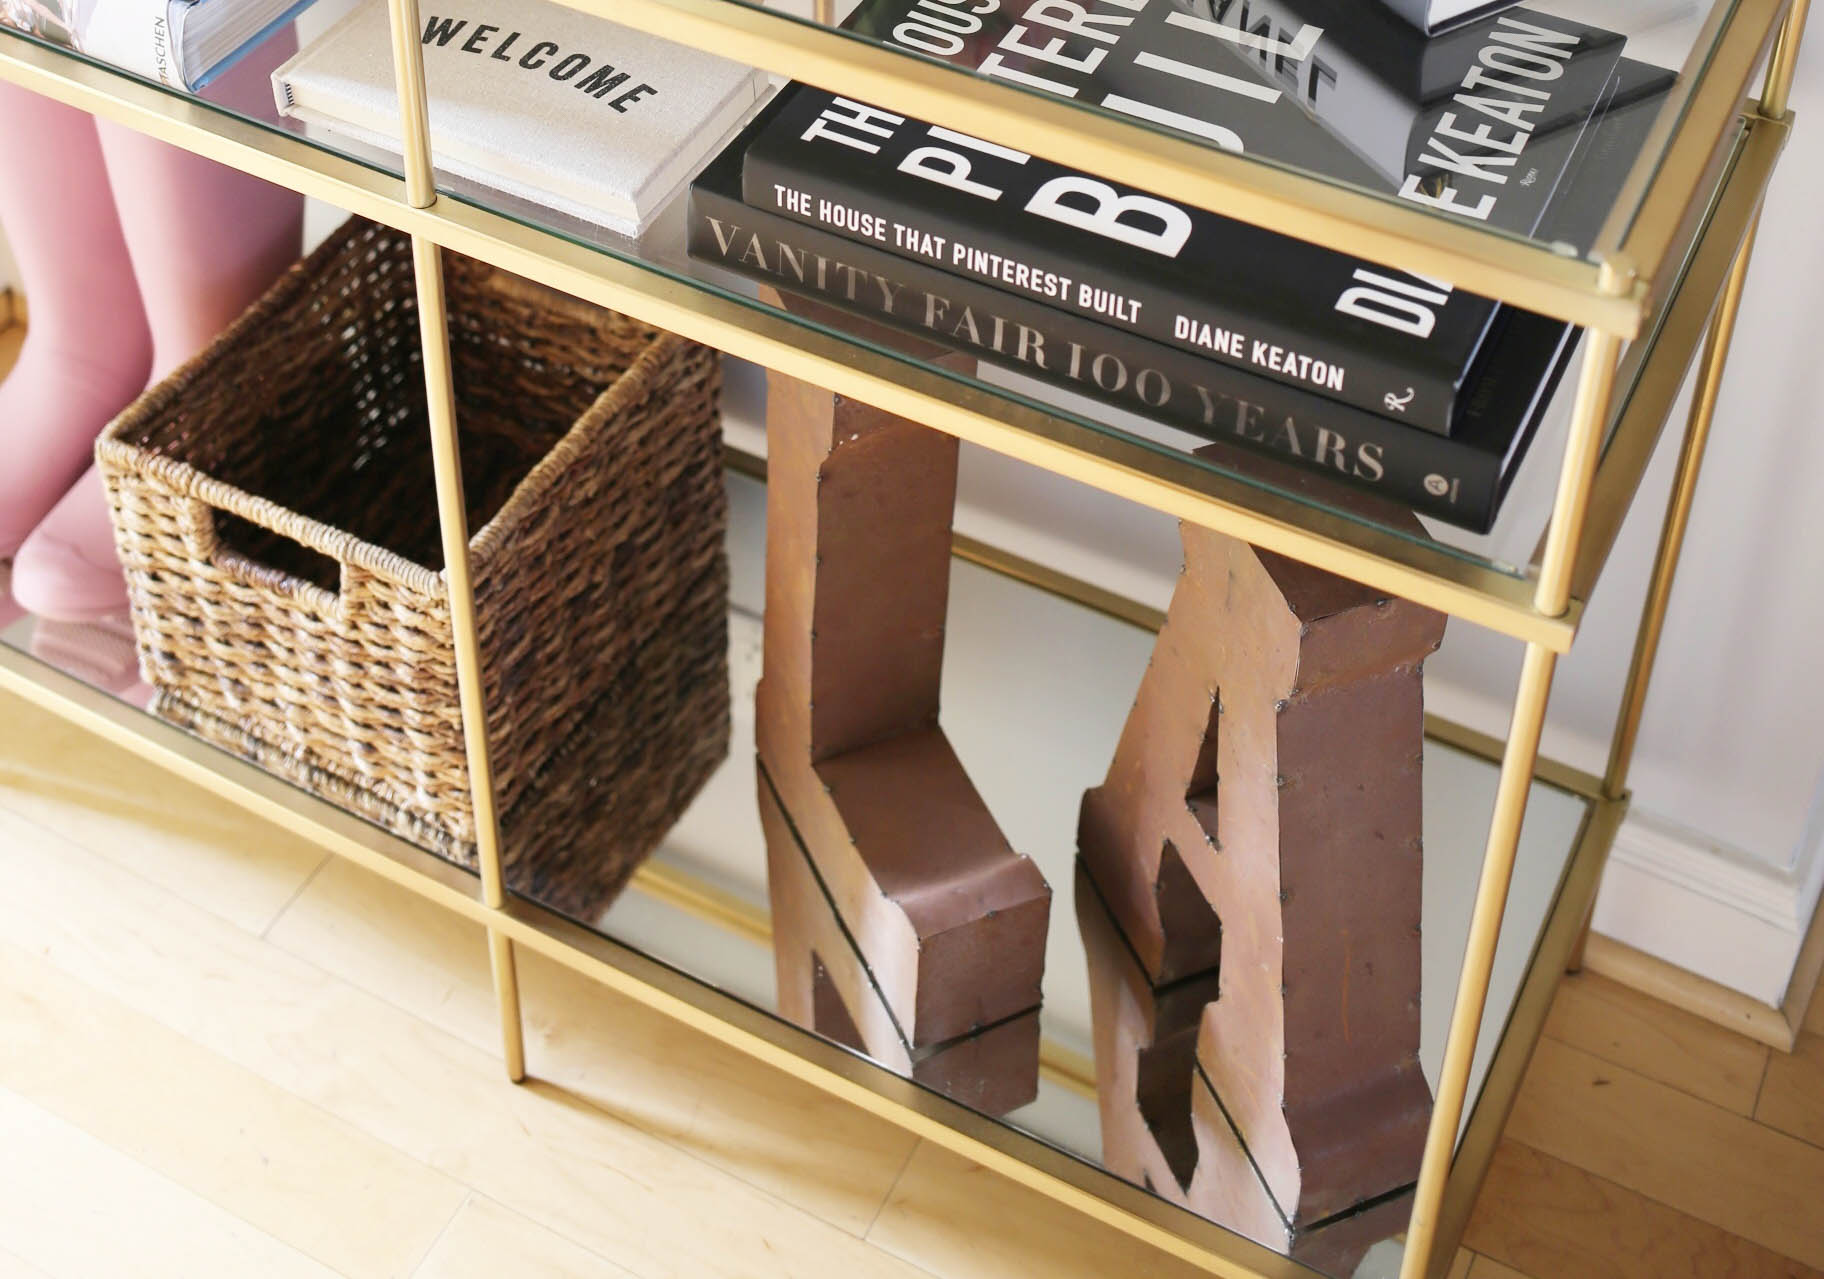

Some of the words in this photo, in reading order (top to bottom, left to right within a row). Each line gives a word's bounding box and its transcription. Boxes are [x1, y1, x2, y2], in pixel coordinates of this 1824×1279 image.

[421, 16, 658, 114] WELCOME
[800, 96, 906, 155] TH
[1417, 16, 1581, 185] KEATON
[706, 216, 903, 314] VANITY
[922, 290, 1049, 370] FAIR
[1067, 341, 1172, 408] 100
[1193, 384, 1385, 483] YEARS
[774, 183, 812, 217] THE
[819, 199, 887, 242] HOUSE
[894, 223, 946, 261] THAT
[953, 242, 1072, 301] PINTEREST
[1078, 282, 1142, 324] BUILT
[1174, 314, 1245, 359] DIANE
[1251, 339, 1345, 392] KEATON
